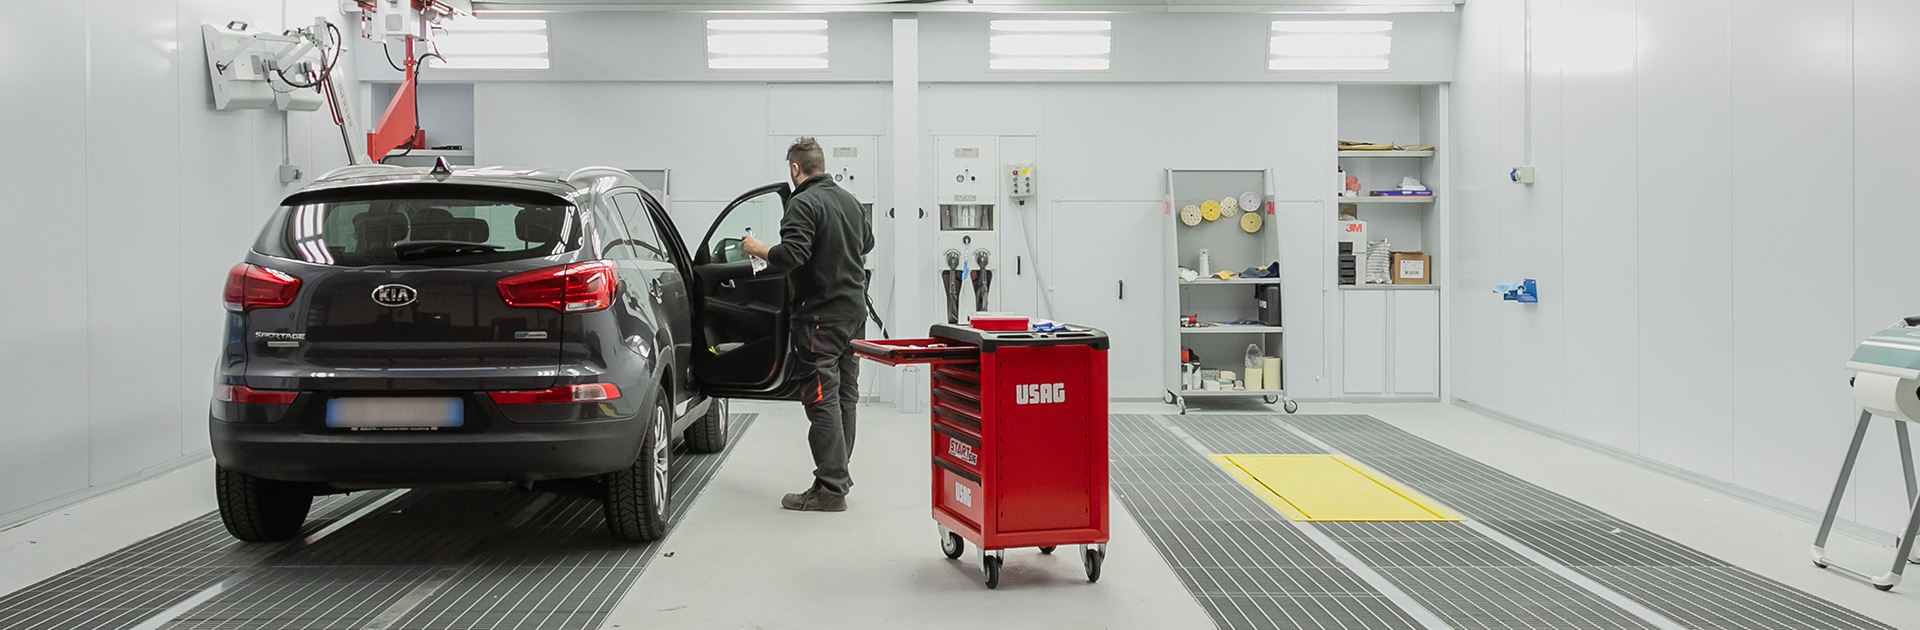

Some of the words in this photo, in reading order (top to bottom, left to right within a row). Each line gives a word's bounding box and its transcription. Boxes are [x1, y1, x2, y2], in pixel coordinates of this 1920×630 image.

[1345, 223, 1363, 233] 3M
[378, 288, 410, 302] KIA
[254, 331, 306, 340] SPORTAGE
[1016, 383, 1065, 404] USAG
[950, 439, 971, 458] START
[956, 482, 971, 507] USAG
